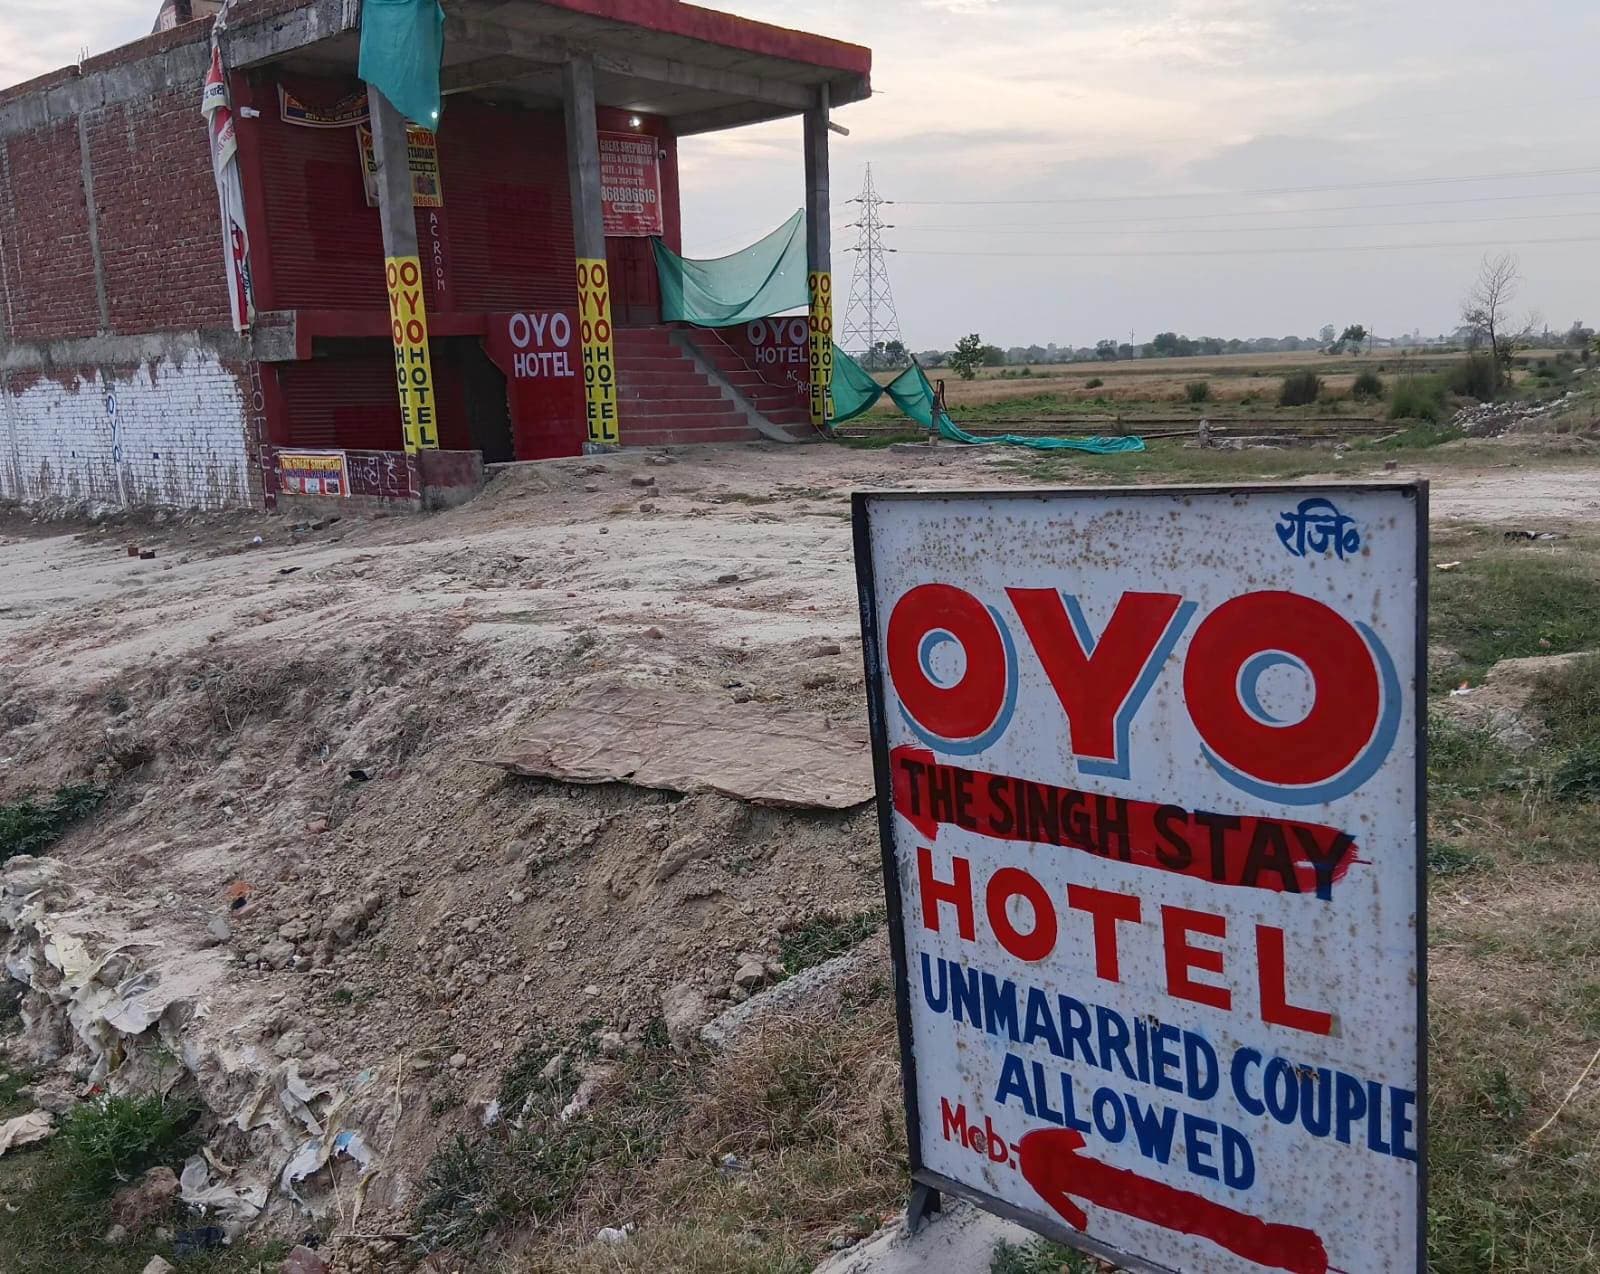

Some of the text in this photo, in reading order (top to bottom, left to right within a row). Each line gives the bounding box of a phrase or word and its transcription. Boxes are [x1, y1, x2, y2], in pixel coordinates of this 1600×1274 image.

[400, 261, 435, 445] OYO HOTEL
[508, 312, 571, 349] OYO
[513, 351, 575, 378] HOTEL
[591, 264, 615, 440] OYO HOTEL
[747, 318, 808, 346] OYO
[755, 347, 808, 364] HOTEL
[886, 583, 1401, 805] OYO
[901, 758, 1356, 901] THE SINGH STAY
[916, 847, 1333, 1037] HOTEL
[920, 952, 1417, 1162] UNMARRIED COUPLE
[994, 1053, 1256, 1191] ALLOWED
